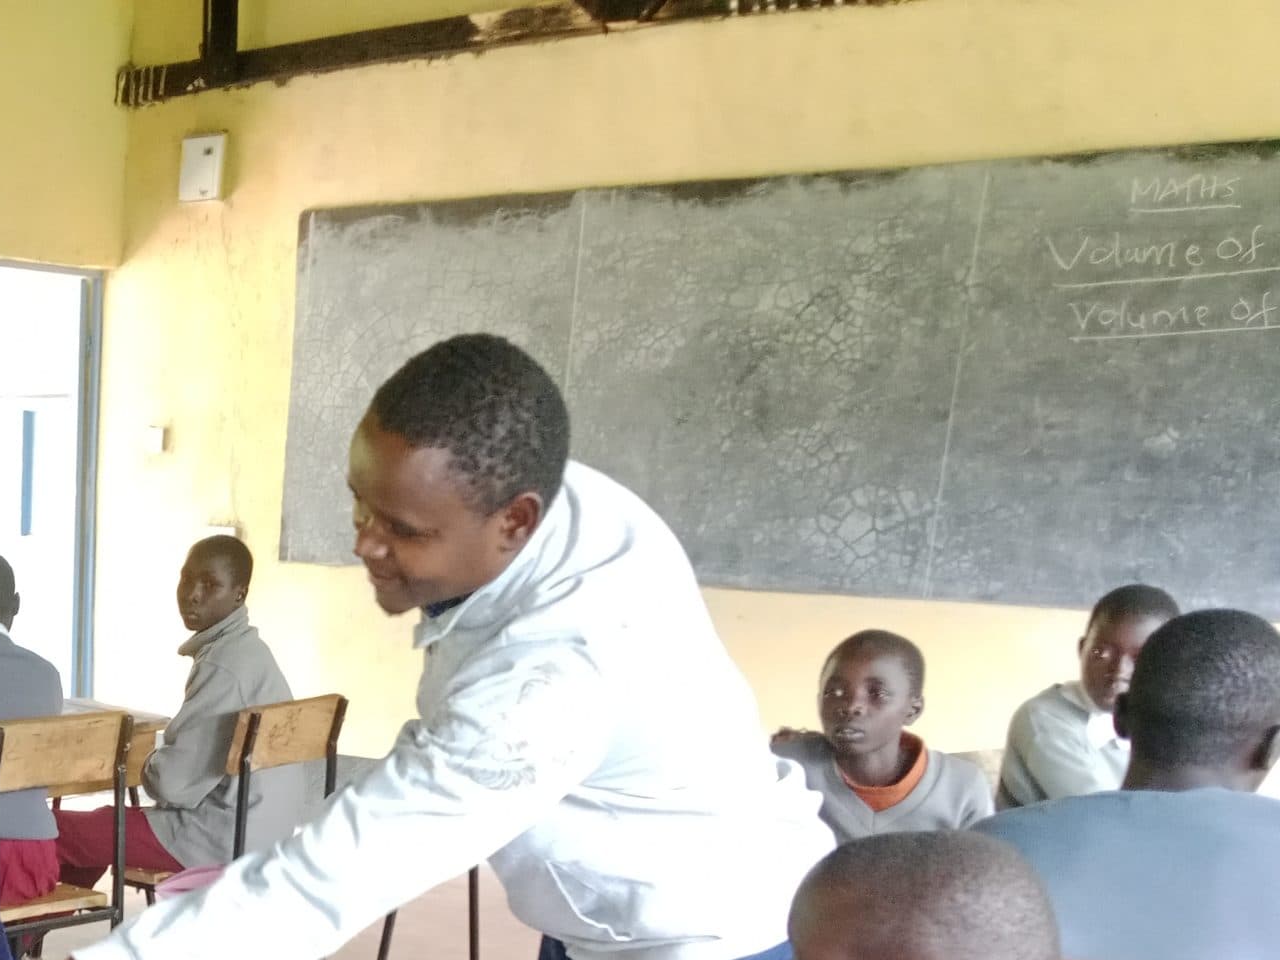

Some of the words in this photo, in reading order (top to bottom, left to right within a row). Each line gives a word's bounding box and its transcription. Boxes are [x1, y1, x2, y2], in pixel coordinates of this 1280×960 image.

[1131, 174, 1241, 203] MATHS
[1045, 230, 1204, 271] Volume
[1069, 299, 1209, 331] Volume
